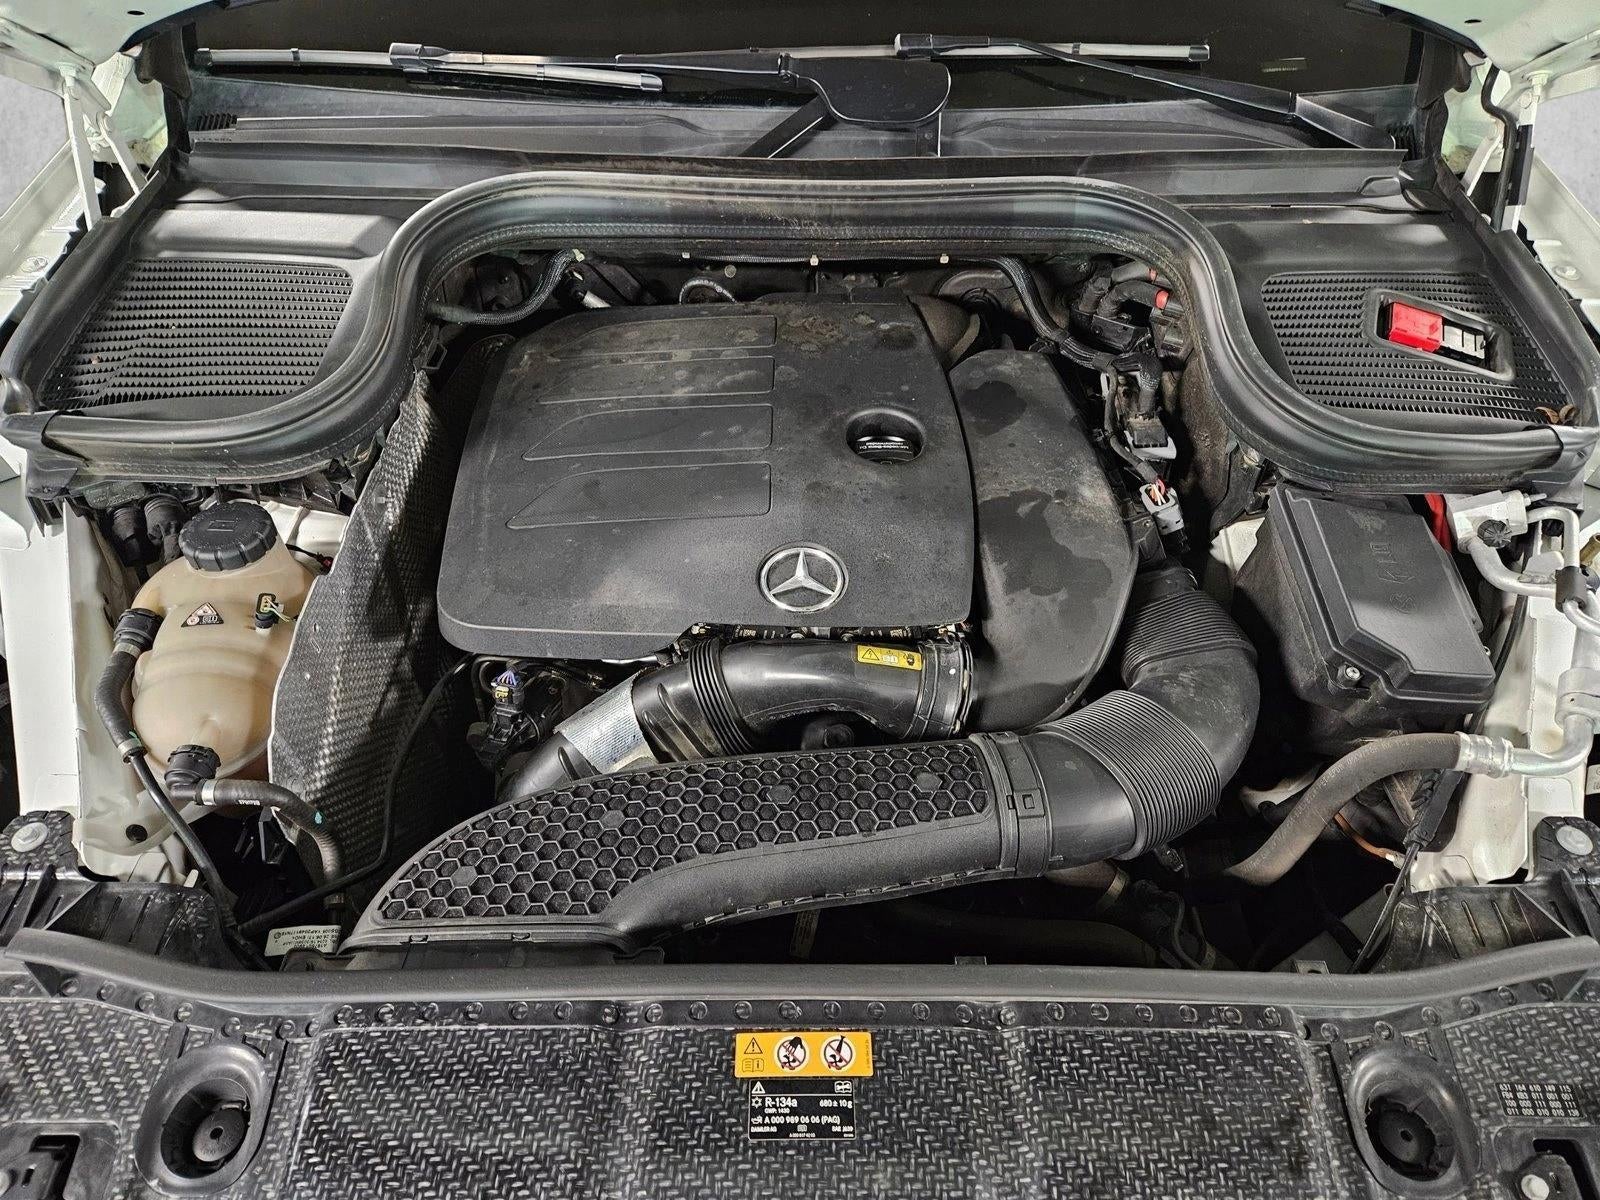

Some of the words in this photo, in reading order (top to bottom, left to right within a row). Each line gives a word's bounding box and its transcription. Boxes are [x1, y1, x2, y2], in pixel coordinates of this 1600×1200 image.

[765, 1096, 798, 1107] R-134a
[820, 1099, 832, 1107] 680
[839, 1099, 847, 1107] 10
[764, 1116, 770, 1124] A
[770, 1116, 784, 1124] 000
[786, 1116, 800, 1124] 989
[800, 1116, 810, 1124] 06
[810, 1116, 820, 1124] 06
[821, 1116, 840, 1124] (PAG)
